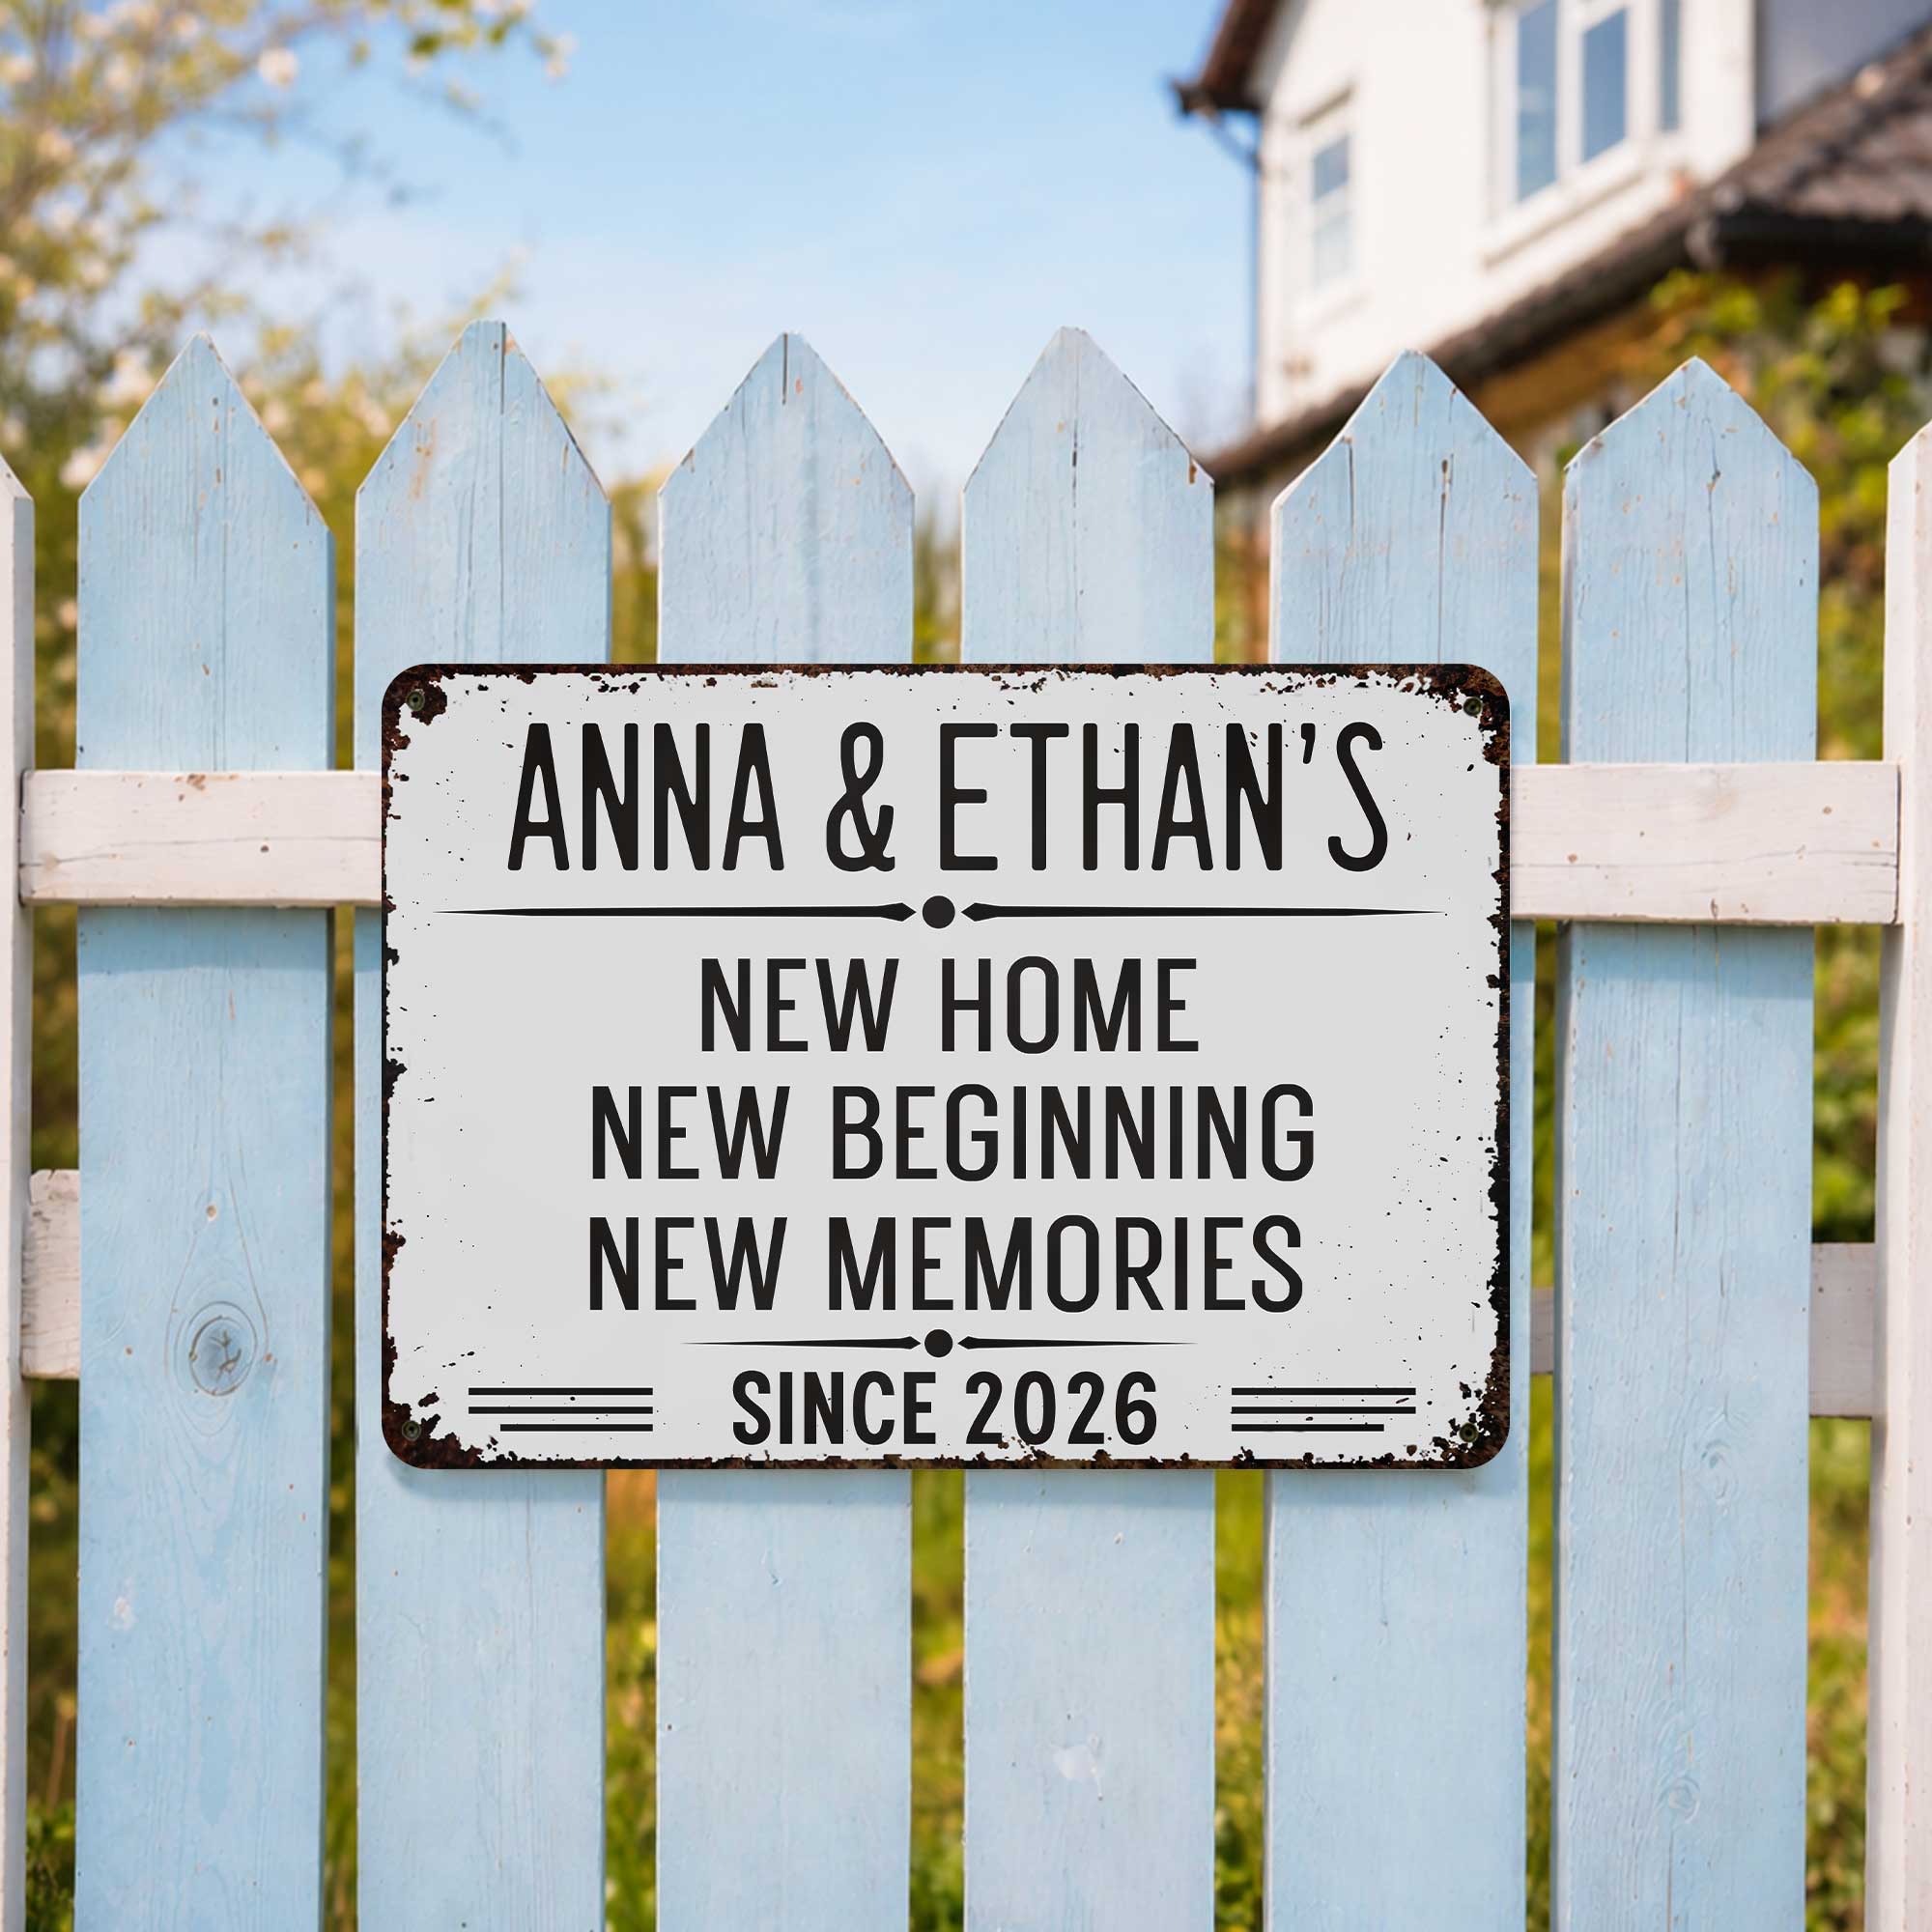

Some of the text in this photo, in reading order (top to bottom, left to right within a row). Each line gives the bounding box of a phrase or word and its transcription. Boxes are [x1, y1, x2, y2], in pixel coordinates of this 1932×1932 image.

[508, 721, 1388, 872] ANNA & ETHAN'S
[701, 955, 1199, 1055] NEW HOME
[592, 1083, 1314, 1182] NEW BEGINNING
[589, 1214, 1303, 1313] NEW MEMORIES
[732, 1370, 1157, 1446] SINCE 2026
